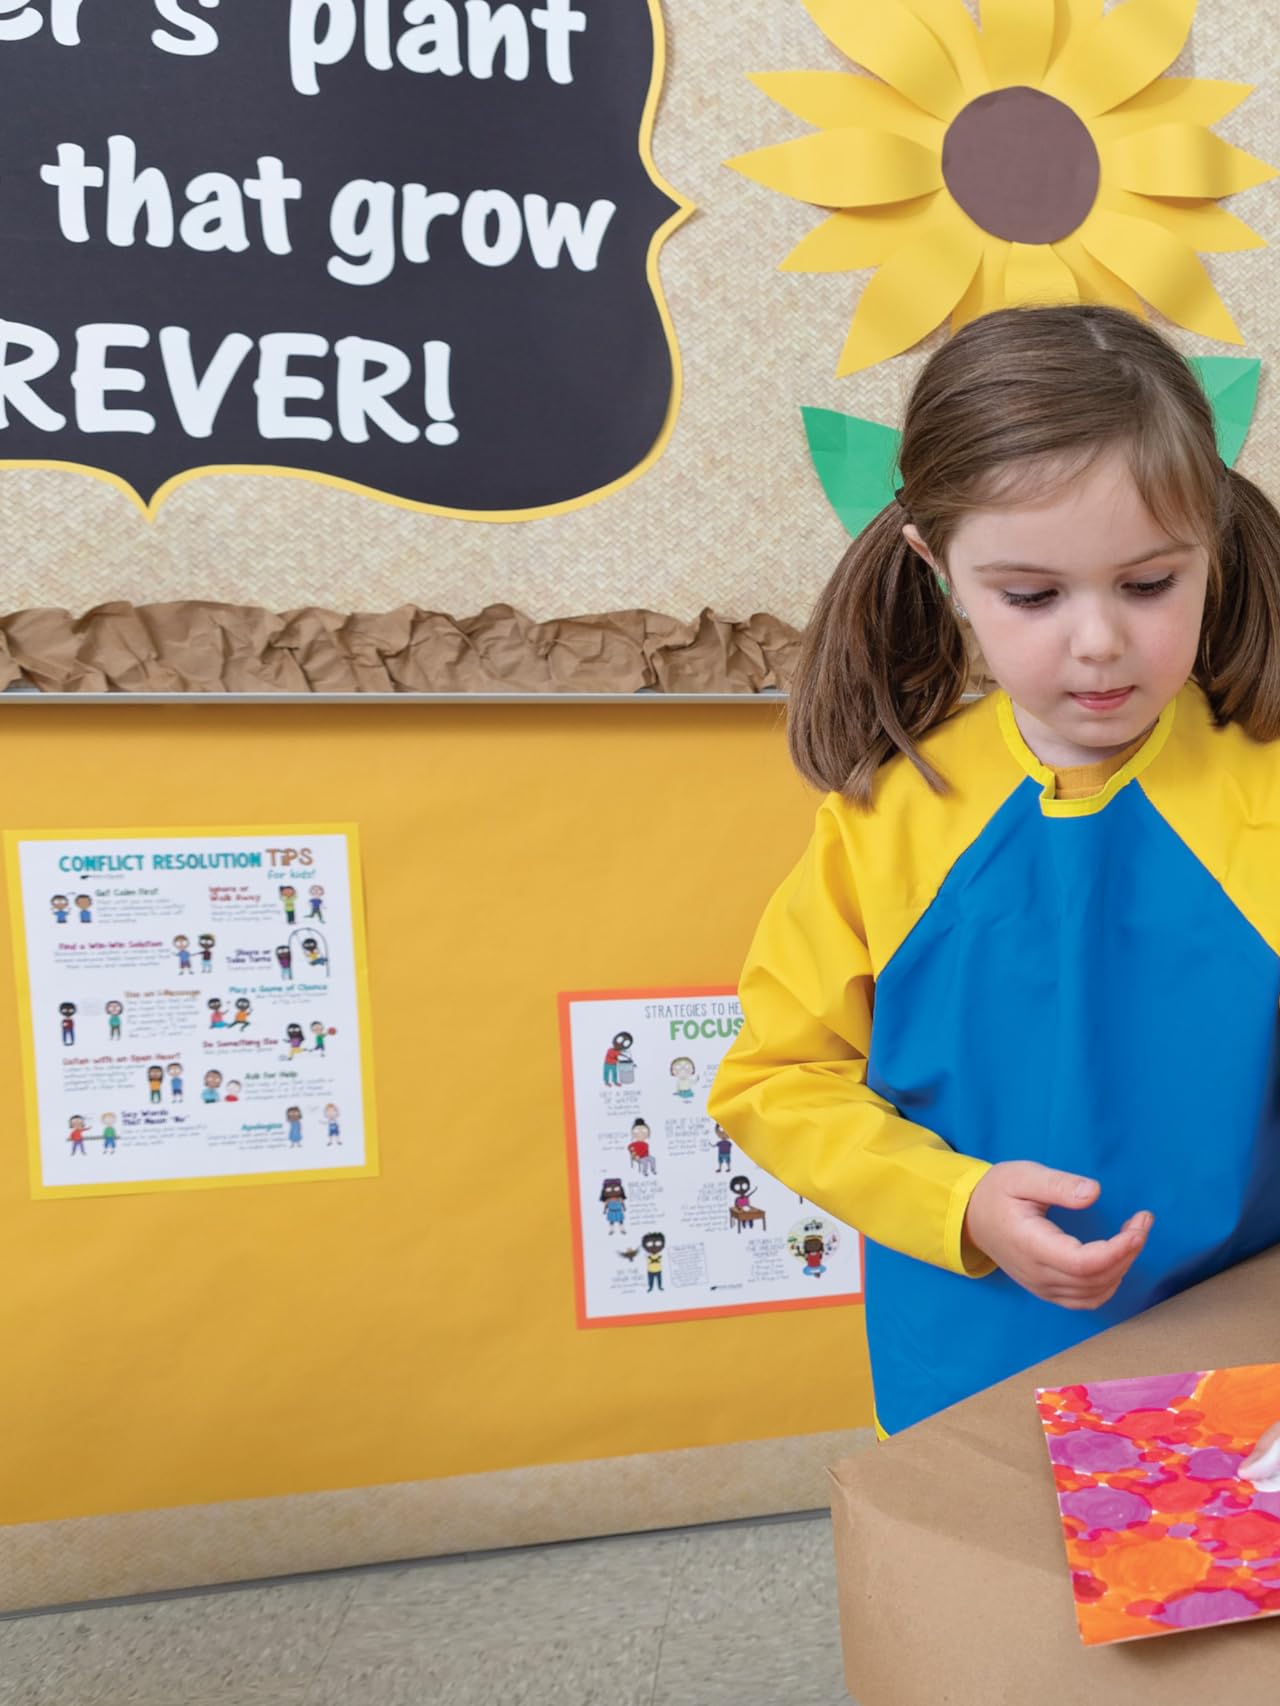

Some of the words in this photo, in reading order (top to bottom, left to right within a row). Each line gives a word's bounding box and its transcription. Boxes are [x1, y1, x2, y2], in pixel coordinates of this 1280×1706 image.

[290, 0, 587, 95] plant
[40, 135, 302, 255] that
[327, 180, 616, 286] grow
[59, 854, 145, 872] CONFLICT
[152, 851, 262, 871] RESOLUTION
[266, 847, 313, 866] TIPS
[644, 1003, 707, 1019] STRATEGIES
[712, 1002, 725, 1017] TO
[728, 1001, 744, 1016] HE
